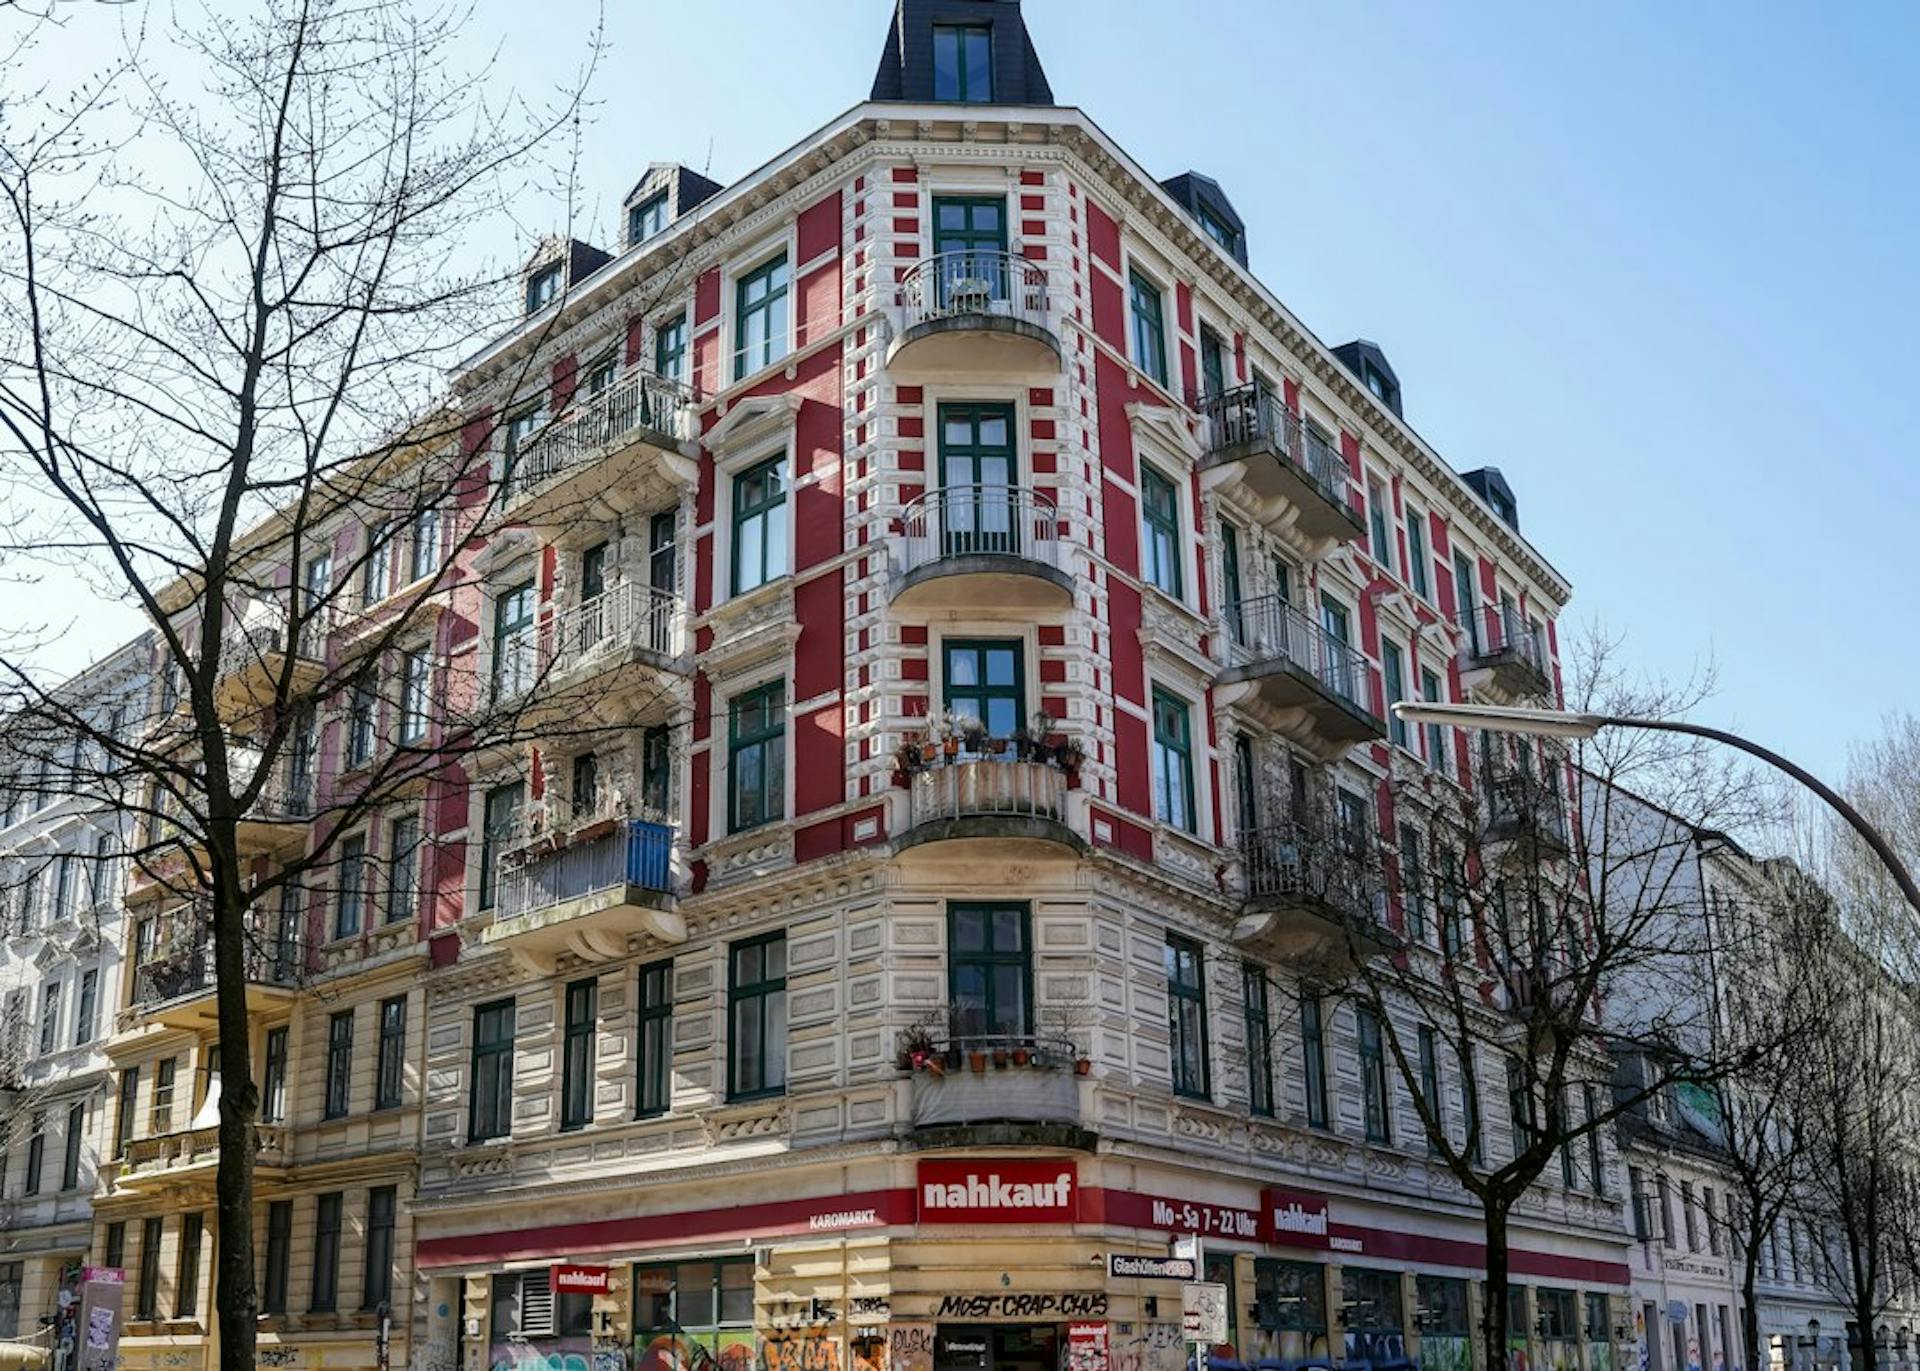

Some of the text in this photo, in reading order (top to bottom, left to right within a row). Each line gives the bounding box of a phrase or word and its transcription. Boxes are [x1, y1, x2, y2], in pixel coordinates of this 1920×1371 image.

[923, 1173, 1072, 1208] nahkauf
[809, 1209, 876, 1229] KAROMARKT
[1235, 1211, 1257, 1237] Uhr
[1273, 1203, 1329, 1236] nahkauf
[1113, 1257, 1193, 1277] Glashütten
[558, 1271, 608, 1287] nahkauf
